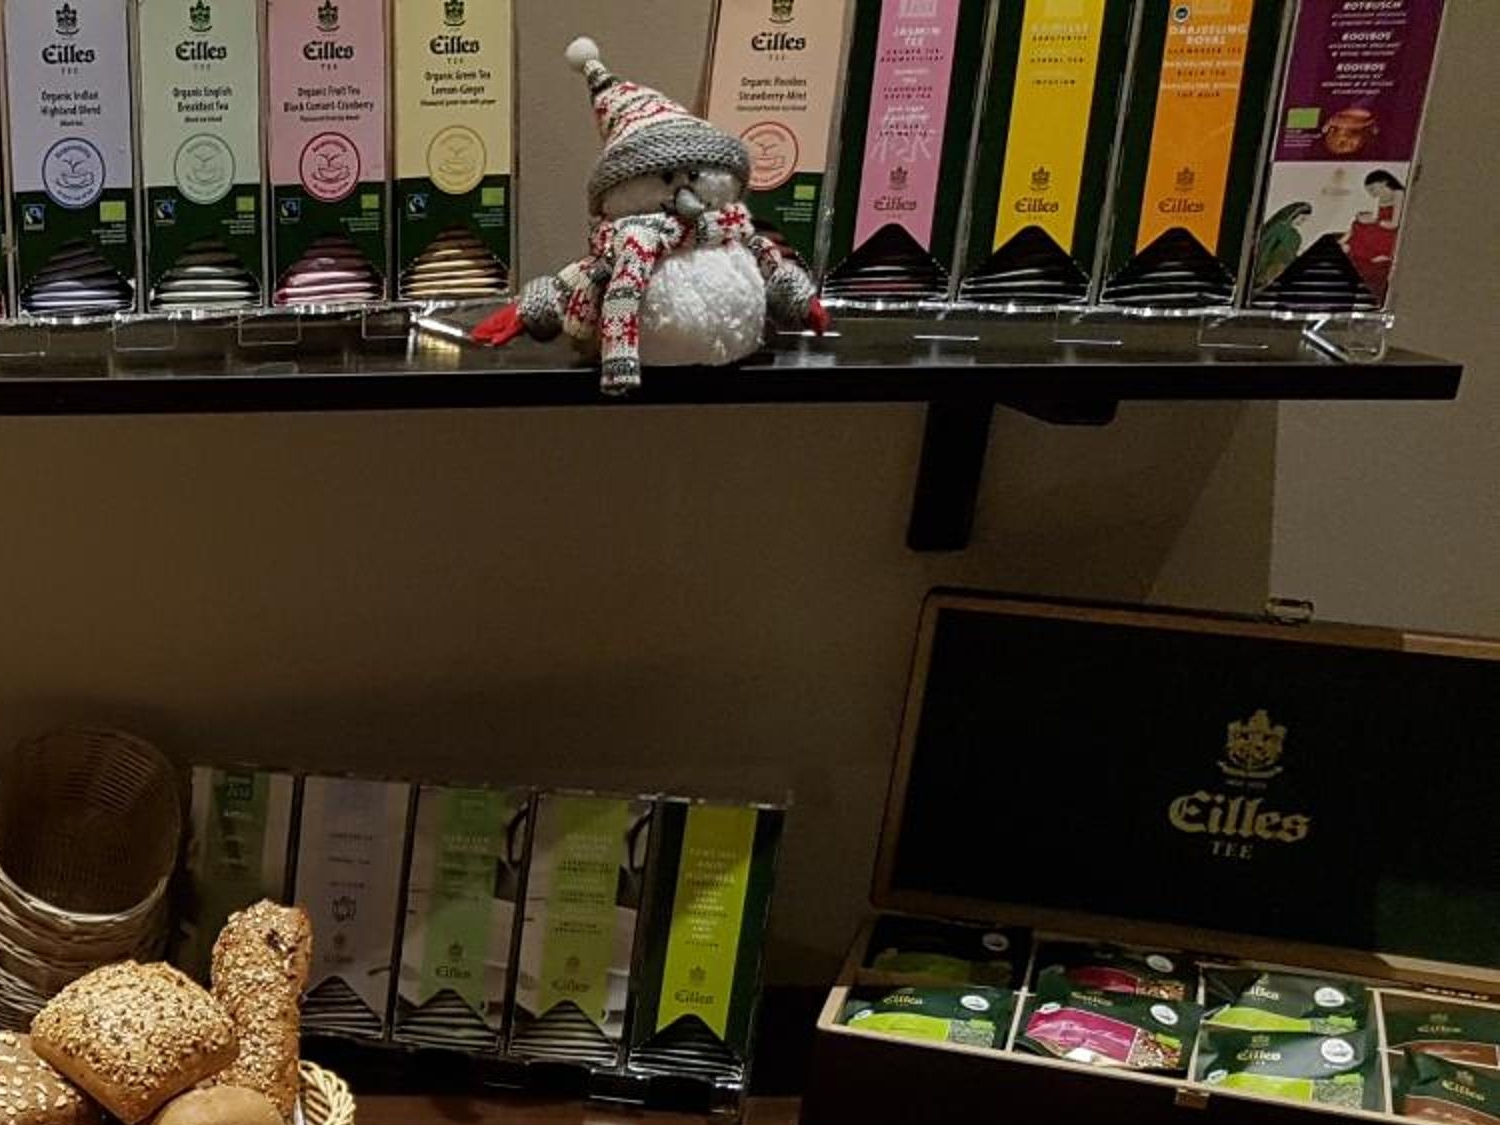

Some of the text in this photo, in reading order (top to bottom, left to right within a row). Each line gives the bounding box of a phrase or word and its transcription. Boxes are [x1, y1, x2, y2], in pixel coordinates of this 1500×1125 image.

[429, 35, 481, 54] Eilles
[751, 32, 807, 51] Eilles
[41, 44, 96, 64] Eilles
[175, 41, 228, 61] Eilles
[303, 41, 354, 60] Eilles
[425, 69, 491, 82] Organic Green Tea
[740, 77, 772, 88] Organic
[41, 89, 99, 102] Organic Indian
[172, 87, 233, 100] Organic English
[297, 85, 361, 99] Organic Fruit Tea
[41, 104, 100, 117] Highland Blend
[177, 100, 229, 112] Breakfast Tea
[283, 101, 304, 113] Black
[873, 196, 918, 210] Eilles
[1014, 197, 1059, 213] Eilles
[1158, 197, 1205, 213] Eilles
[1167, 790, 1312, 843] Eilles
[1211, 840, 1254, 860] TEE
[1236, 1048, 1281, 1061] Eilles
